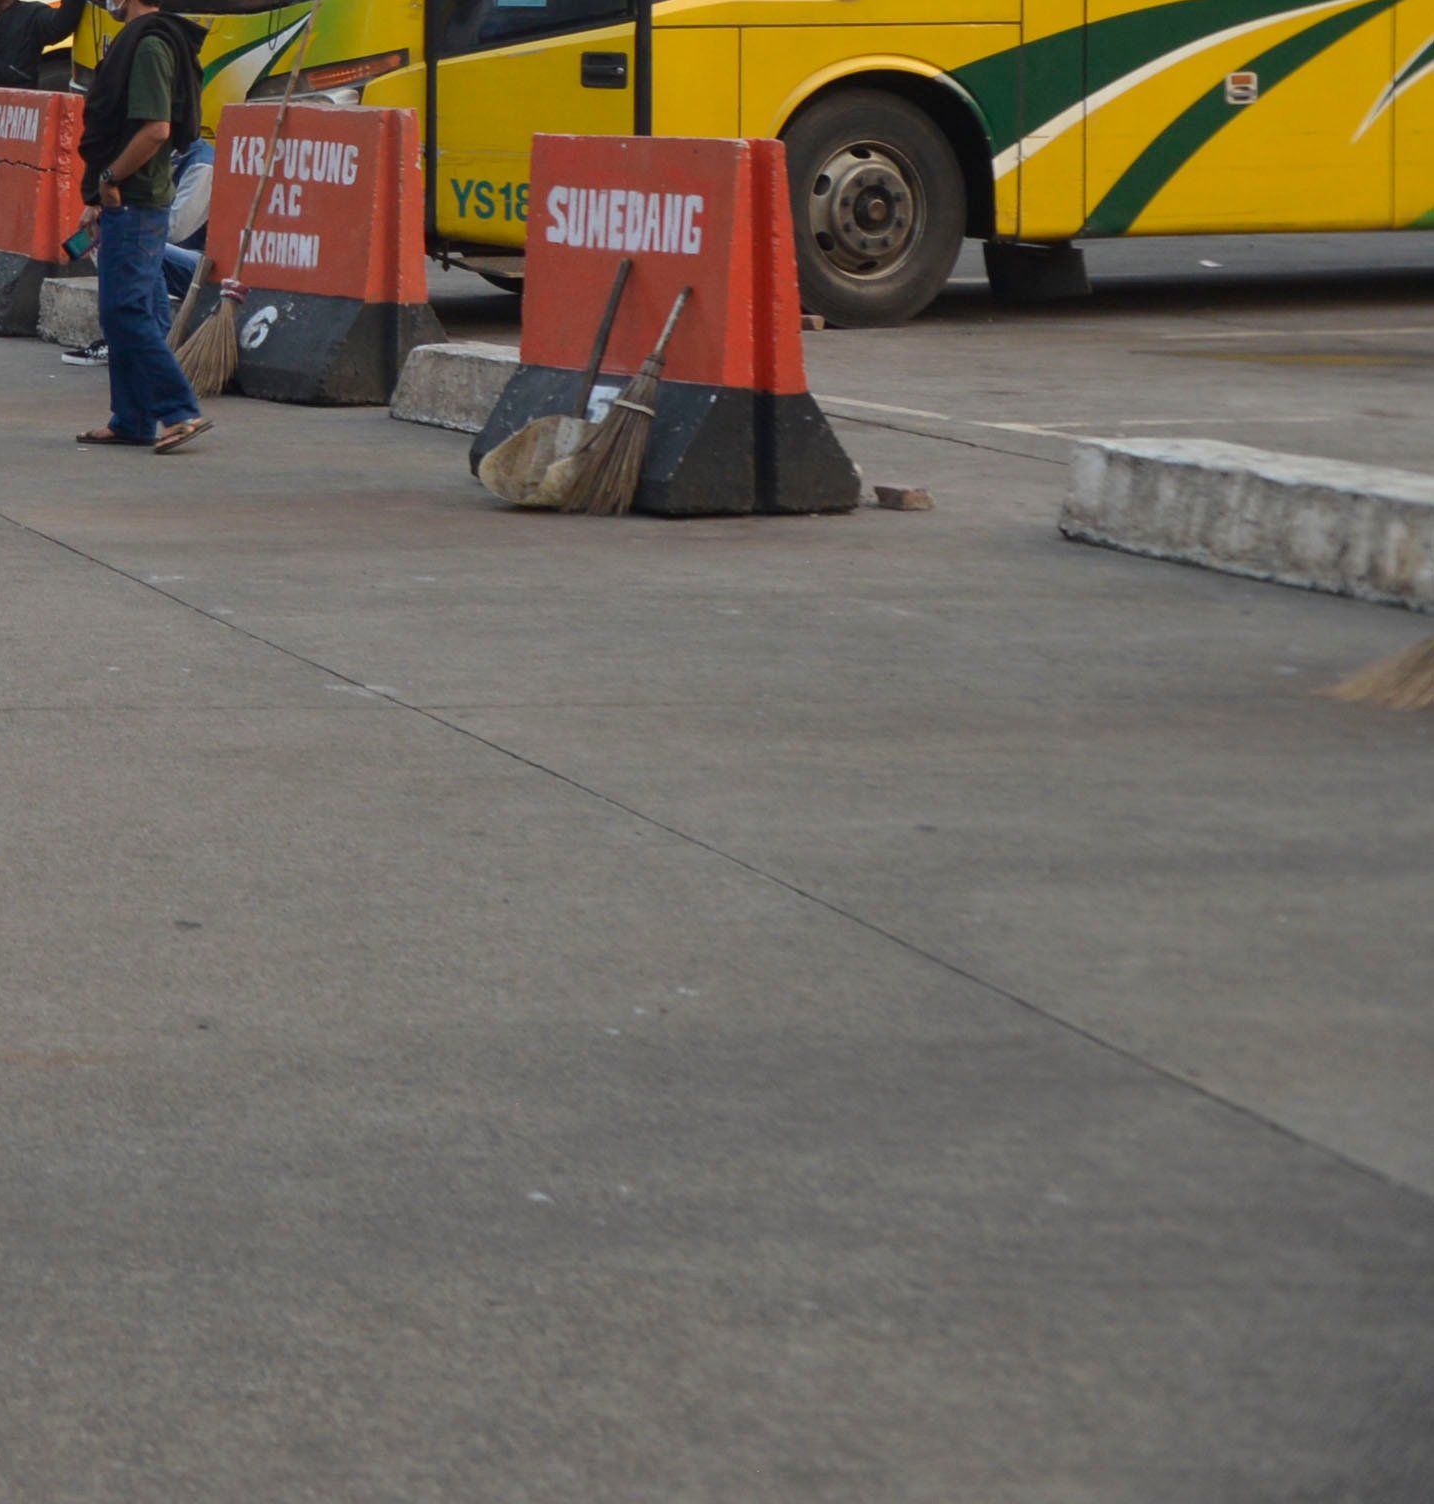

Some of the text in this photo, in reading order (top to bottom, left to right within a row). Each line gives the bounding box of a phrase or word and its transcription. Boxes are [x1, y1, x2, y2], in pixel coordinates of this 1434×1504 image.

[268, 183, 303, 217] AC
[546, 185, 704, 254] SUMEDANG
[240, 305, 278, 349] 6
